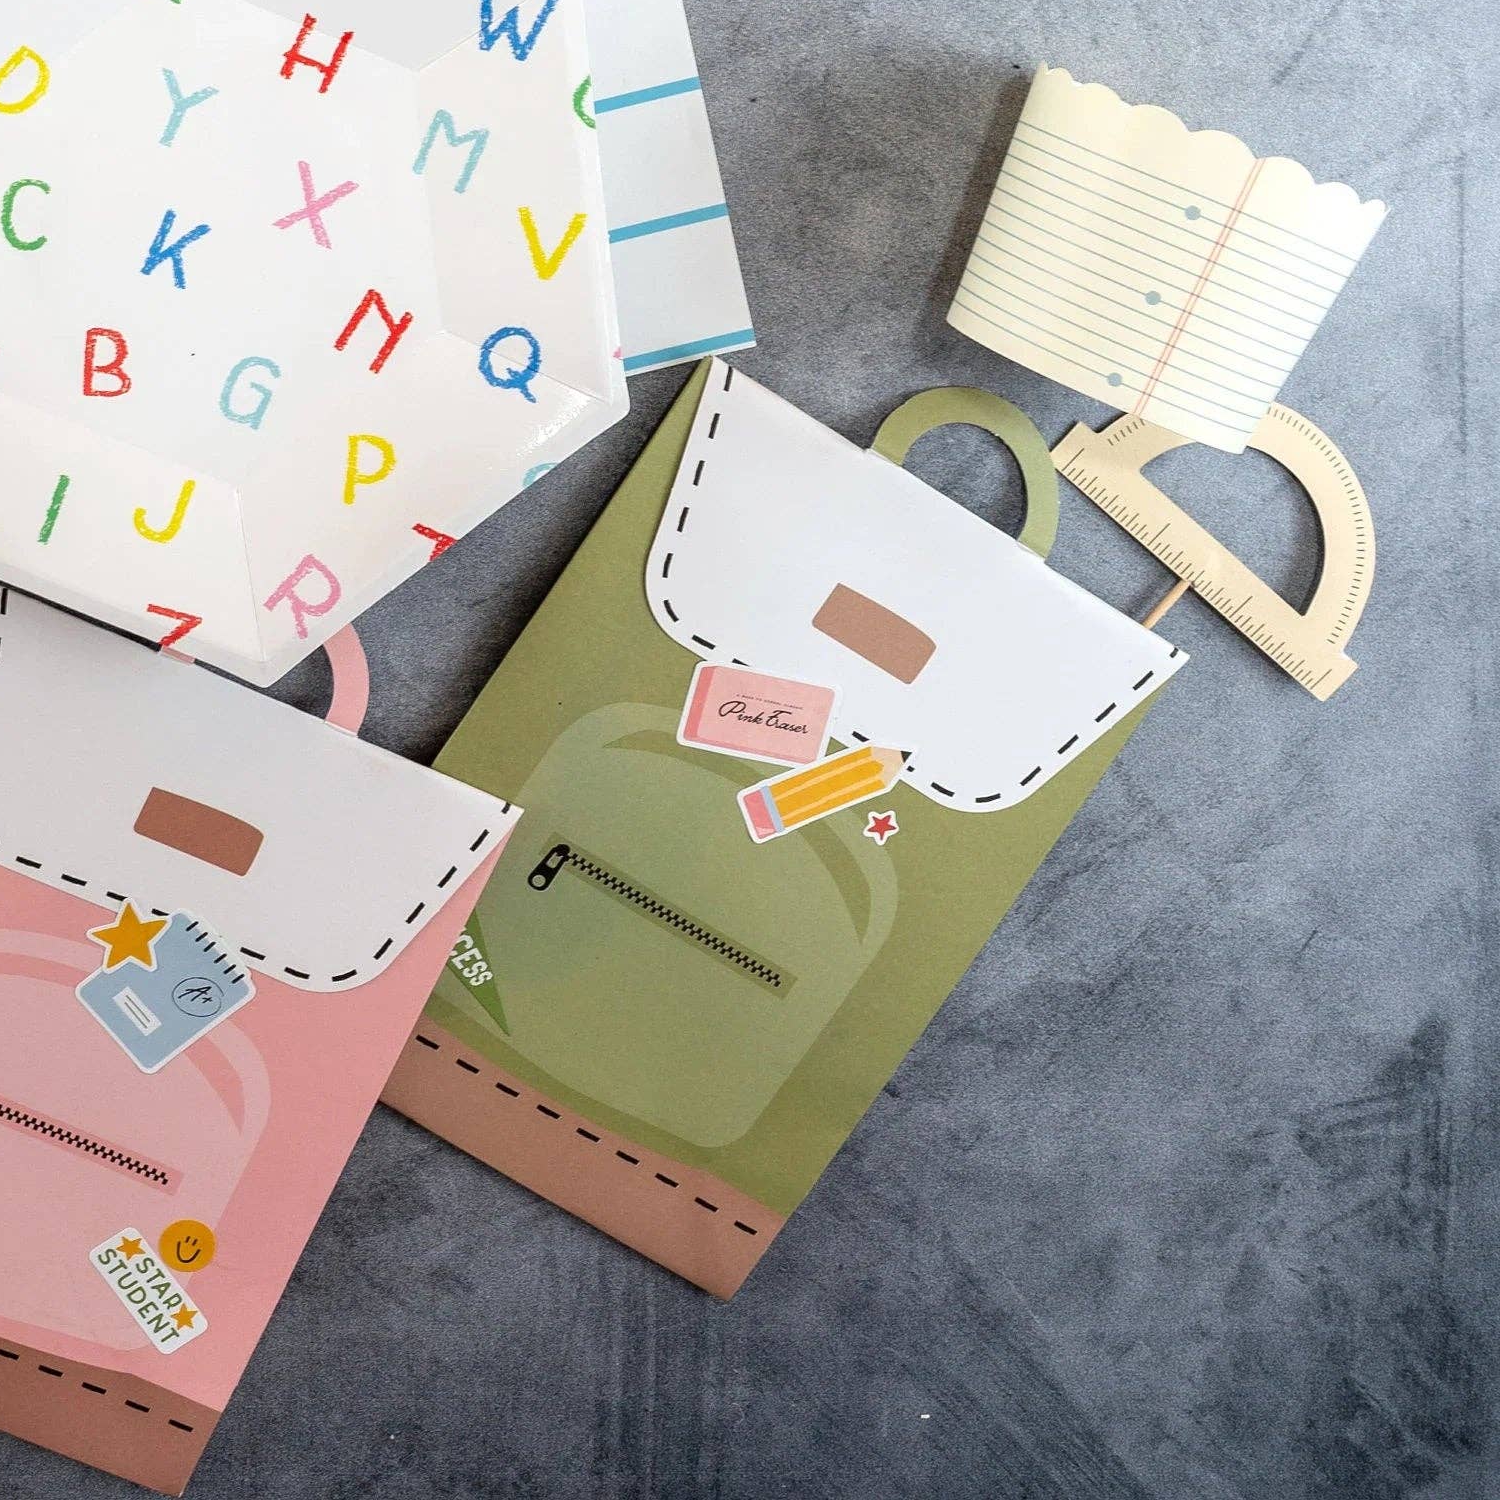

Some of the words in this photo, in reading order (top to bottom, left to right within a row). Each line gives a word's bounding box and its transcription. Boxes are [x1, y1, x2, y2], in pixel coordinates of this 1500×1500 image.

[280, 12, 354, 94] H
[159, 67, 220, 147] Y
[412, 109, 490, 193] M
[0, 178, 51, 251] C
[272, 161, 360, 249] X
[140, 209, 211, 290] K
[516, 206, 588, 281] V
[81, 327, 133, 397] B
[219, 356, 282, 430] G
[478, 326, 542, 404] Q
[342, 432, 398, 506] P
[132, 479, 198, 545] J
[265, 554, 342, 638] R
[718, 700, 764, 725] Pink
[765, 709, 810, 734] Eraser
[449, 927, 494, 986] CESS
[97, 1248, 180, 1343] STUDENT
[136, 1257, 184, 1310] STAR
